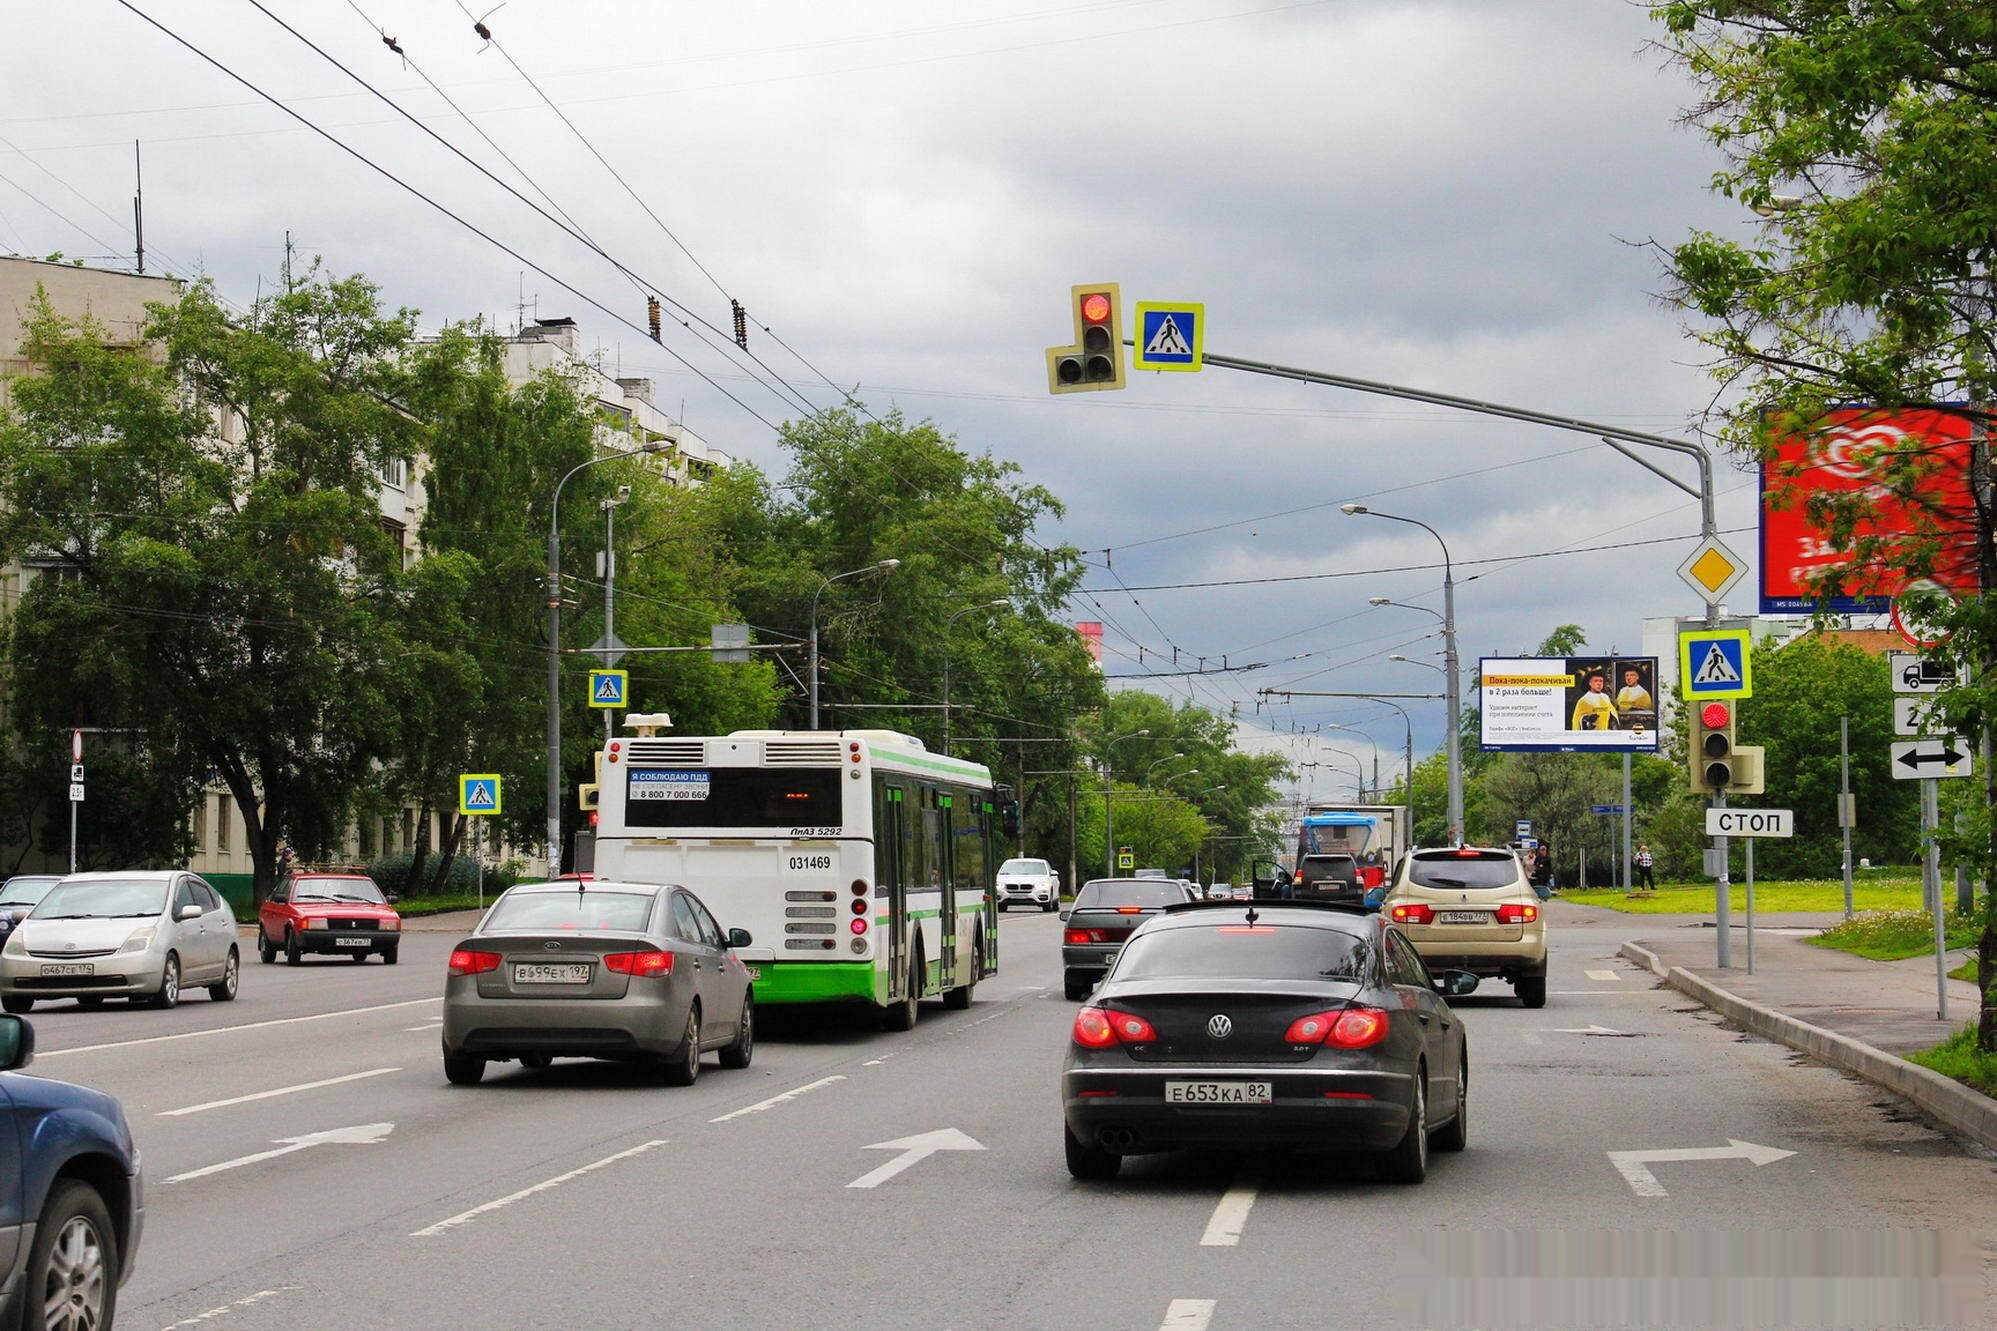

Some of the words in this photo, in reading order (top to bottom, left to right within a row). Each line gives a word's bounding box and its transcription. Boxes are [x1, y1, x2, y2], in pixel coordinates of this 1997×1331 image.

[1489, 676, 1572, 685] Пока-пока-покачивай
[1495, 688, 1501, 696] 2
[1521, 688, 1552, 696] больше!
[640, 773, 689, 781] СОБЛЮДАЮ
[690, 773, 708, 781] ПДД
[1719, 813, 1780, 832] СТОП
[817, 828, 842, 836] 5292
[789, 856, 831, 870] 031469
